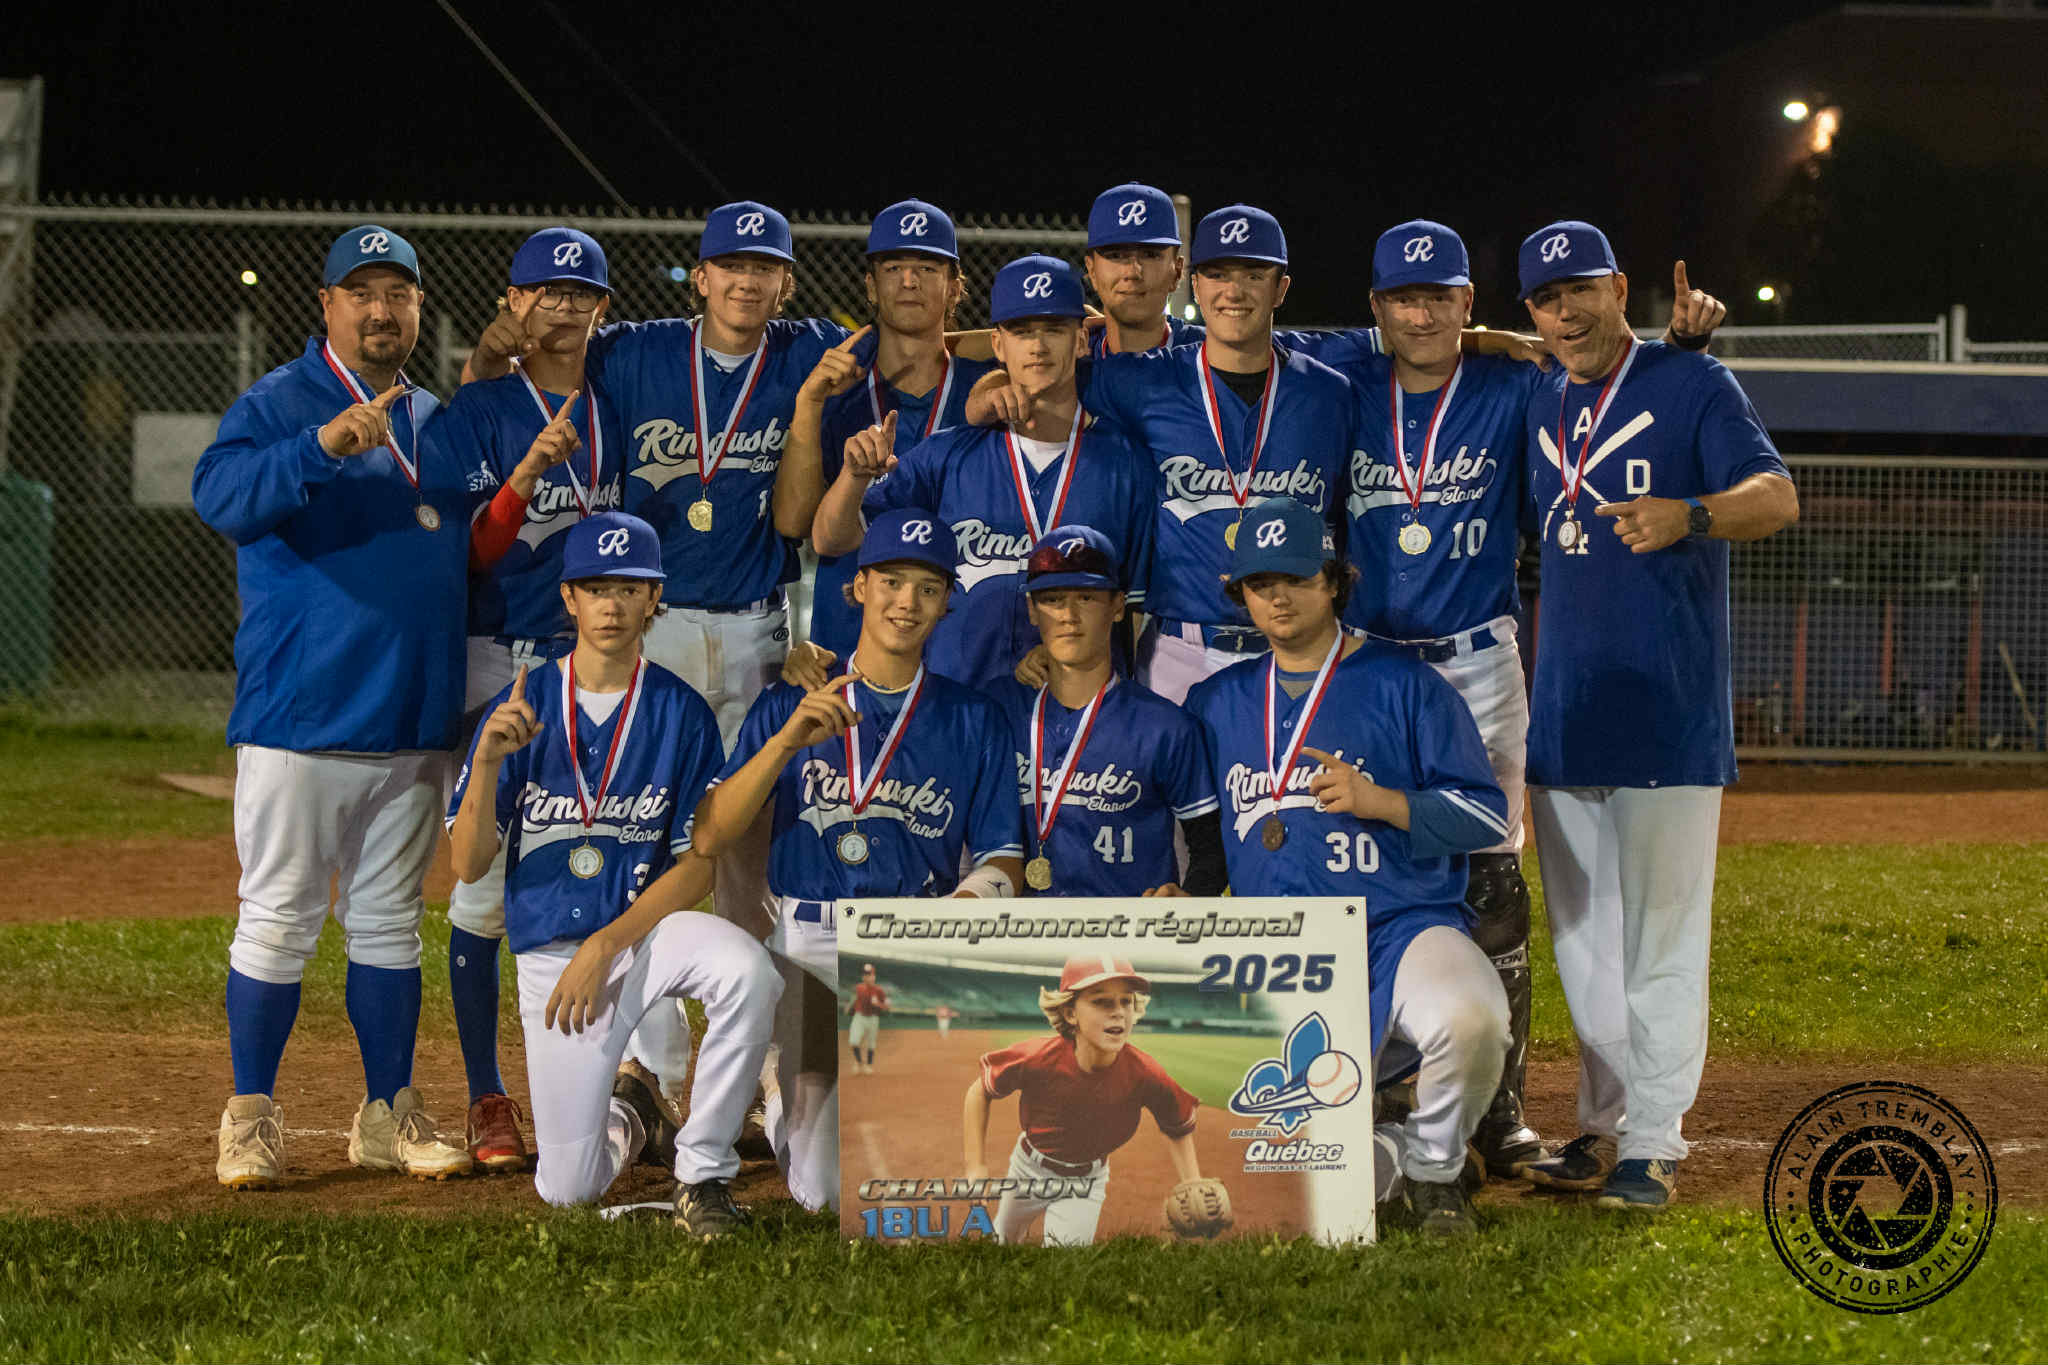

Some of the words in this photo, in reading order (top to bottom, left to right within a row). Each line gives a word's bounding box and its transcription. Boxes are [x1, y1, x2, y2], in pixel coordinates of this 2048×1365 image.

[736, 212, 766, 236] R
[900, 212, 928, 236] R
[1118, 200, 1147, 226] R
[360, 231, 390, 254] R
[1220, 218, 1250, 244] R
[553, 242, 583, 268] R
[1404, 235, 1434, 262] R
[1541, 233, 1571, 263] R
[1023, 271, 1053, 299] R
[633, 418, 790, 466] Rimousk
[1159, 455, 1326, 502] Rimuski
[1350, 445, 1497, 497] Rimski
[1626, 459, 1651, 494] D
[598, 527, 630, 556] R
[902, 519, 932, 545] R
[951, 519, 1033, 567] Rimo
[1256, 518, 1287, 549] R
[1449, 518, 1487, 560] 10
[802, 759, 953, 816] Rimuski
[516, 781, 670, 833] Rimuski
[1093, 826, 1134, 863] 41
[1325, 831, 1379, 873] 30
[856, 912, 1128, 944] Championnat
[1135, 911, 1304, 944] régional
[1200, 953, 1337, 993] 2025
[1245, 1139, 1344, 1162] Québec
[858, 1177, 1096, 1201] CHAMPION
[861, 1206, 950, 1238] 18U
[961, 1205, 997, 1237] A
